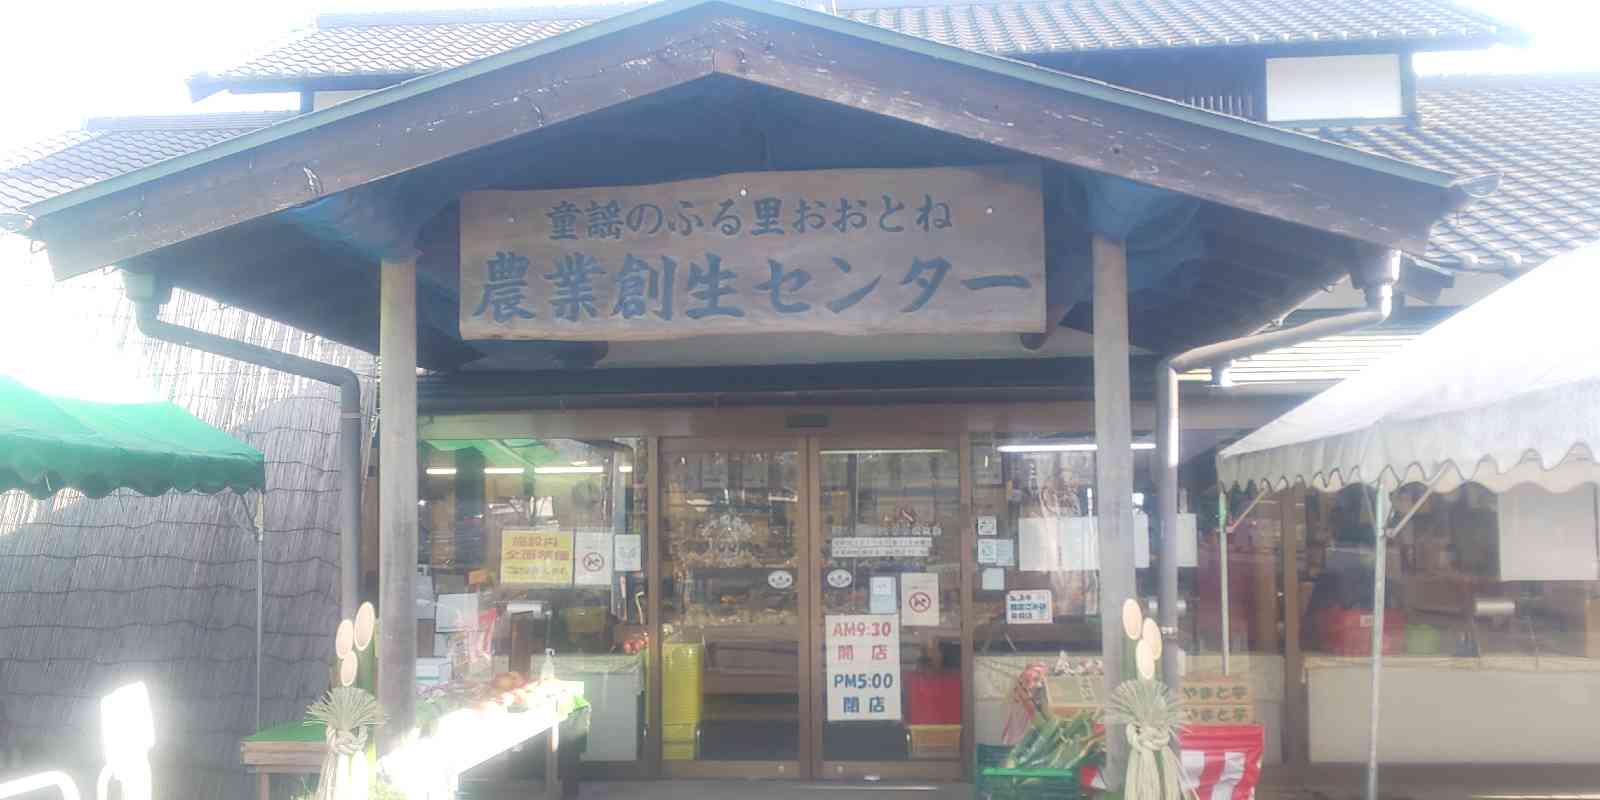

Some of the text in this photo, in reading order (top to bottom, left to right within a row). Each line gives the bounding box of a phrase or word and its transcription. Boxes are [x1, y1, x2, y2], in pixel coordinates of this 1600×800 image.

[545, 193, 953, 241] 童謡のふる里おおとね
[473, 251, 1032, 323] 農業創生センター
[832, 622, 891, 637] AM9:30
[834, 673, 893, 689] PM5:00
